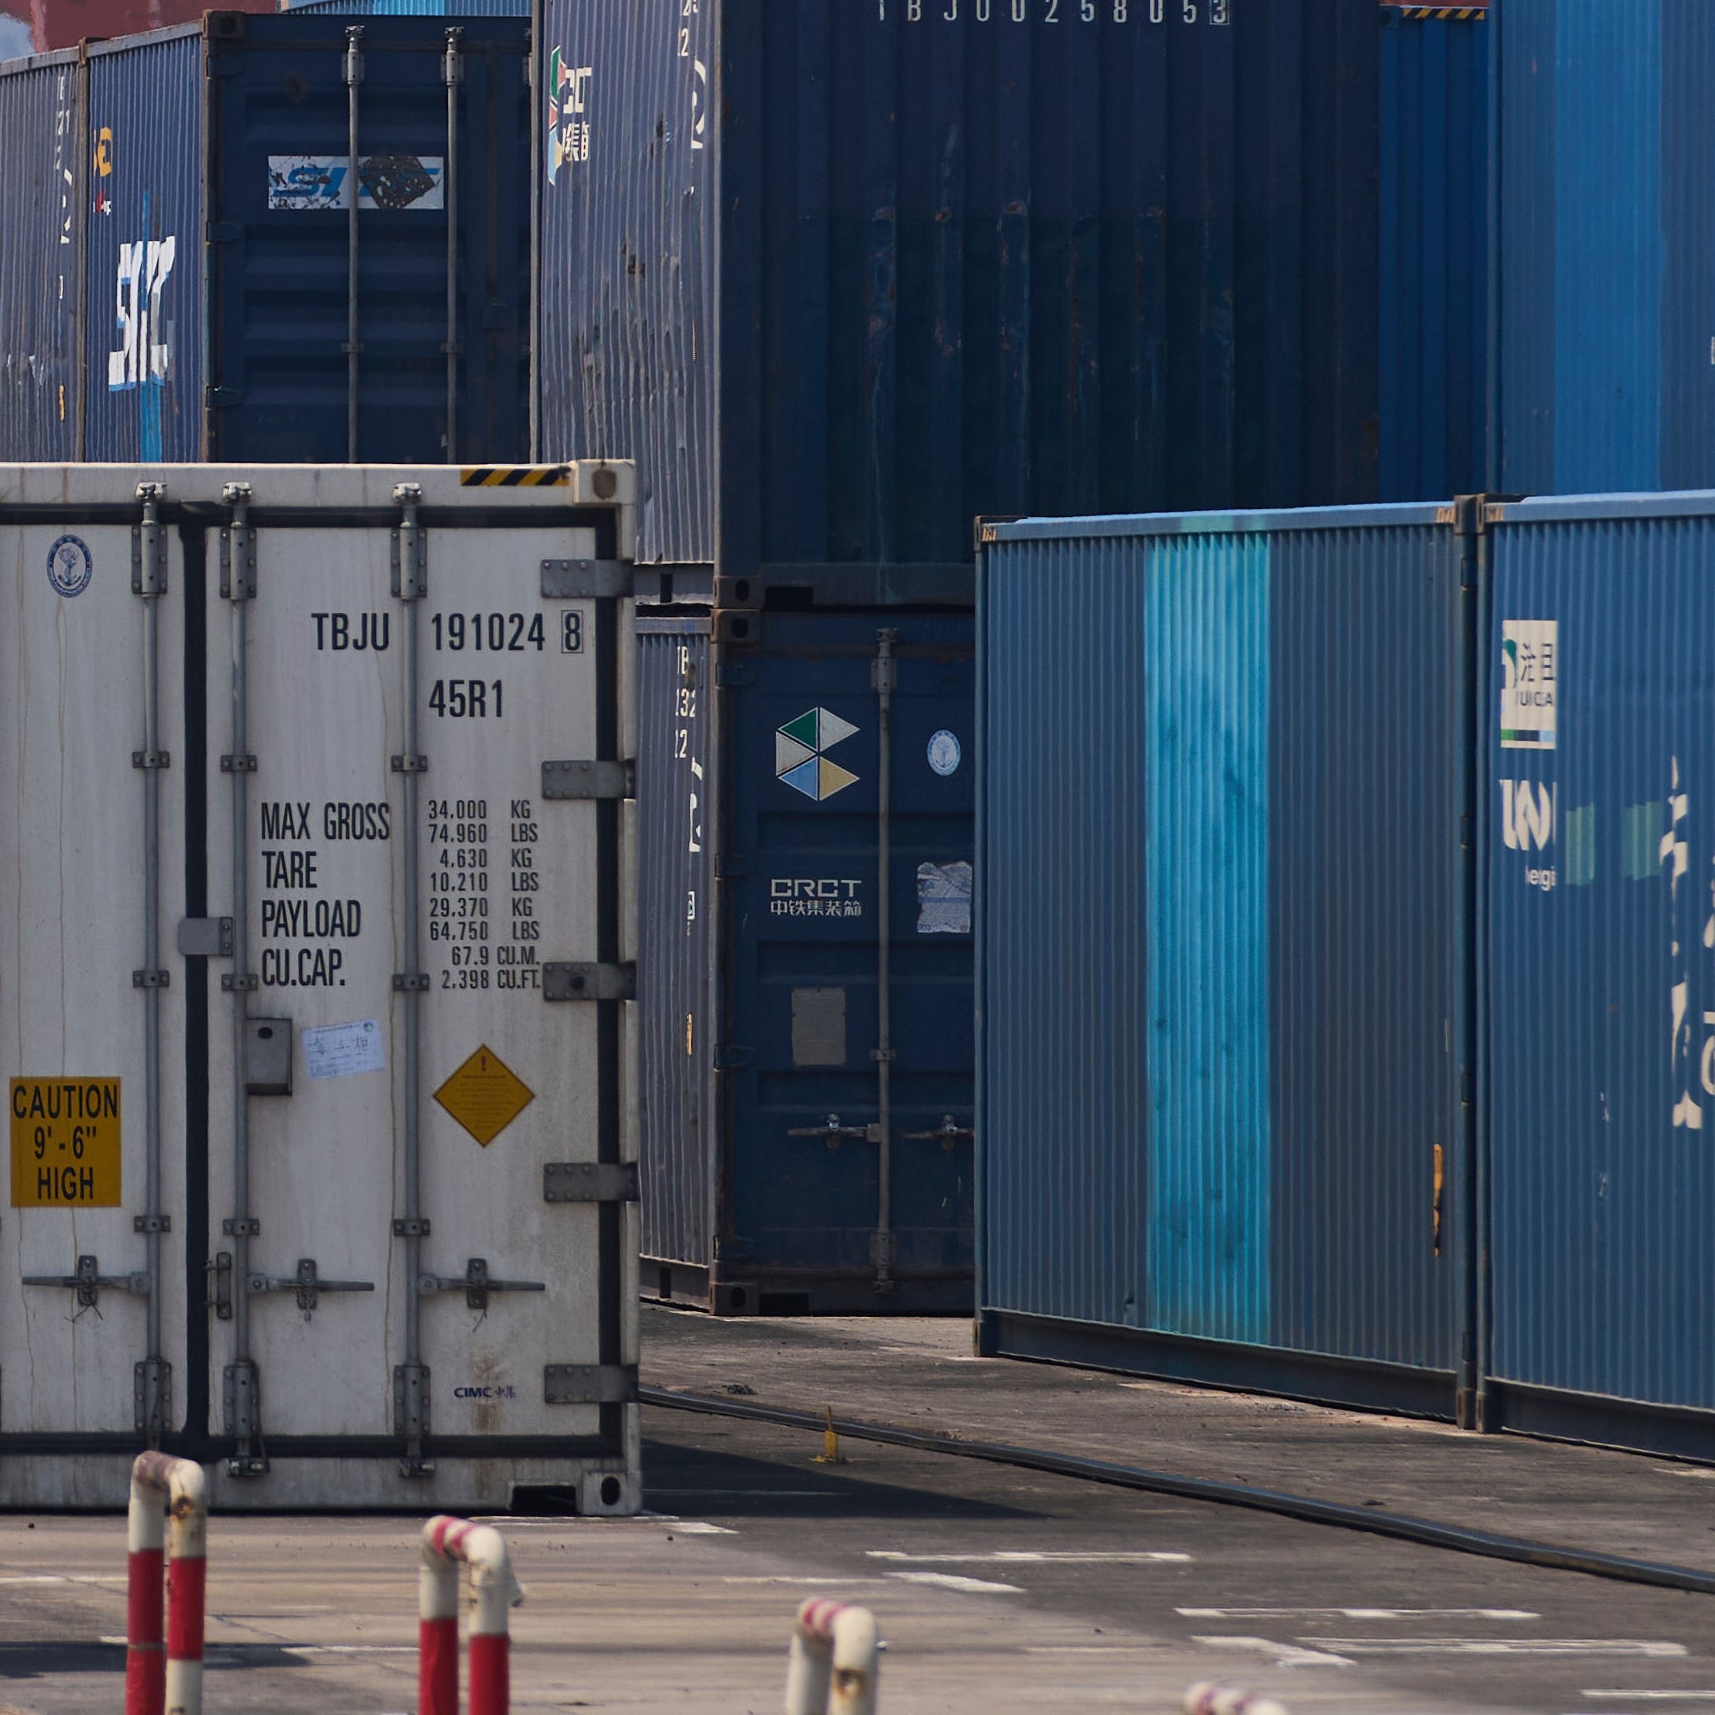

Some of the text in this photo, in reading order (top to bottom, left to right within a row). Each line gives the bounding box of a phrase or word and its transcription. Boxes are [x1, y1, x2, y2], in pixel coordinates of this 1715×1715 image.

[311, 612, 581, 652] TBJU 191024 8
[429, 679, 503, 718] 45R1
[511, 800, 531, 819] KG
[261, 802, 391, 840] MAX GROSS
[511, 823, 538, 843] LBS
[511, 848, 532, 868] KG
[261, 851, 318, 889] TARE
[512, 872, 539, 892] LBS
[771, 878, 862, 897] CRCT
[512, 897, 532, 918] KG
[770, 900, 862, 917] 中铁集装箱
[261, 900, 362, 938] PAYLOAD
[512, 921, 540, 941] LBS
[497, 945, 540, 966] CU.M.
[261, 948, 346, 986] CU.CAP.
[497, 969, 541, 989] CU.FT.
[13, 1084, 118, 1119] CAUTION
[37, 1166, 94, 1201] HIGH
[453, 1386, 493, 1399] CIMC
